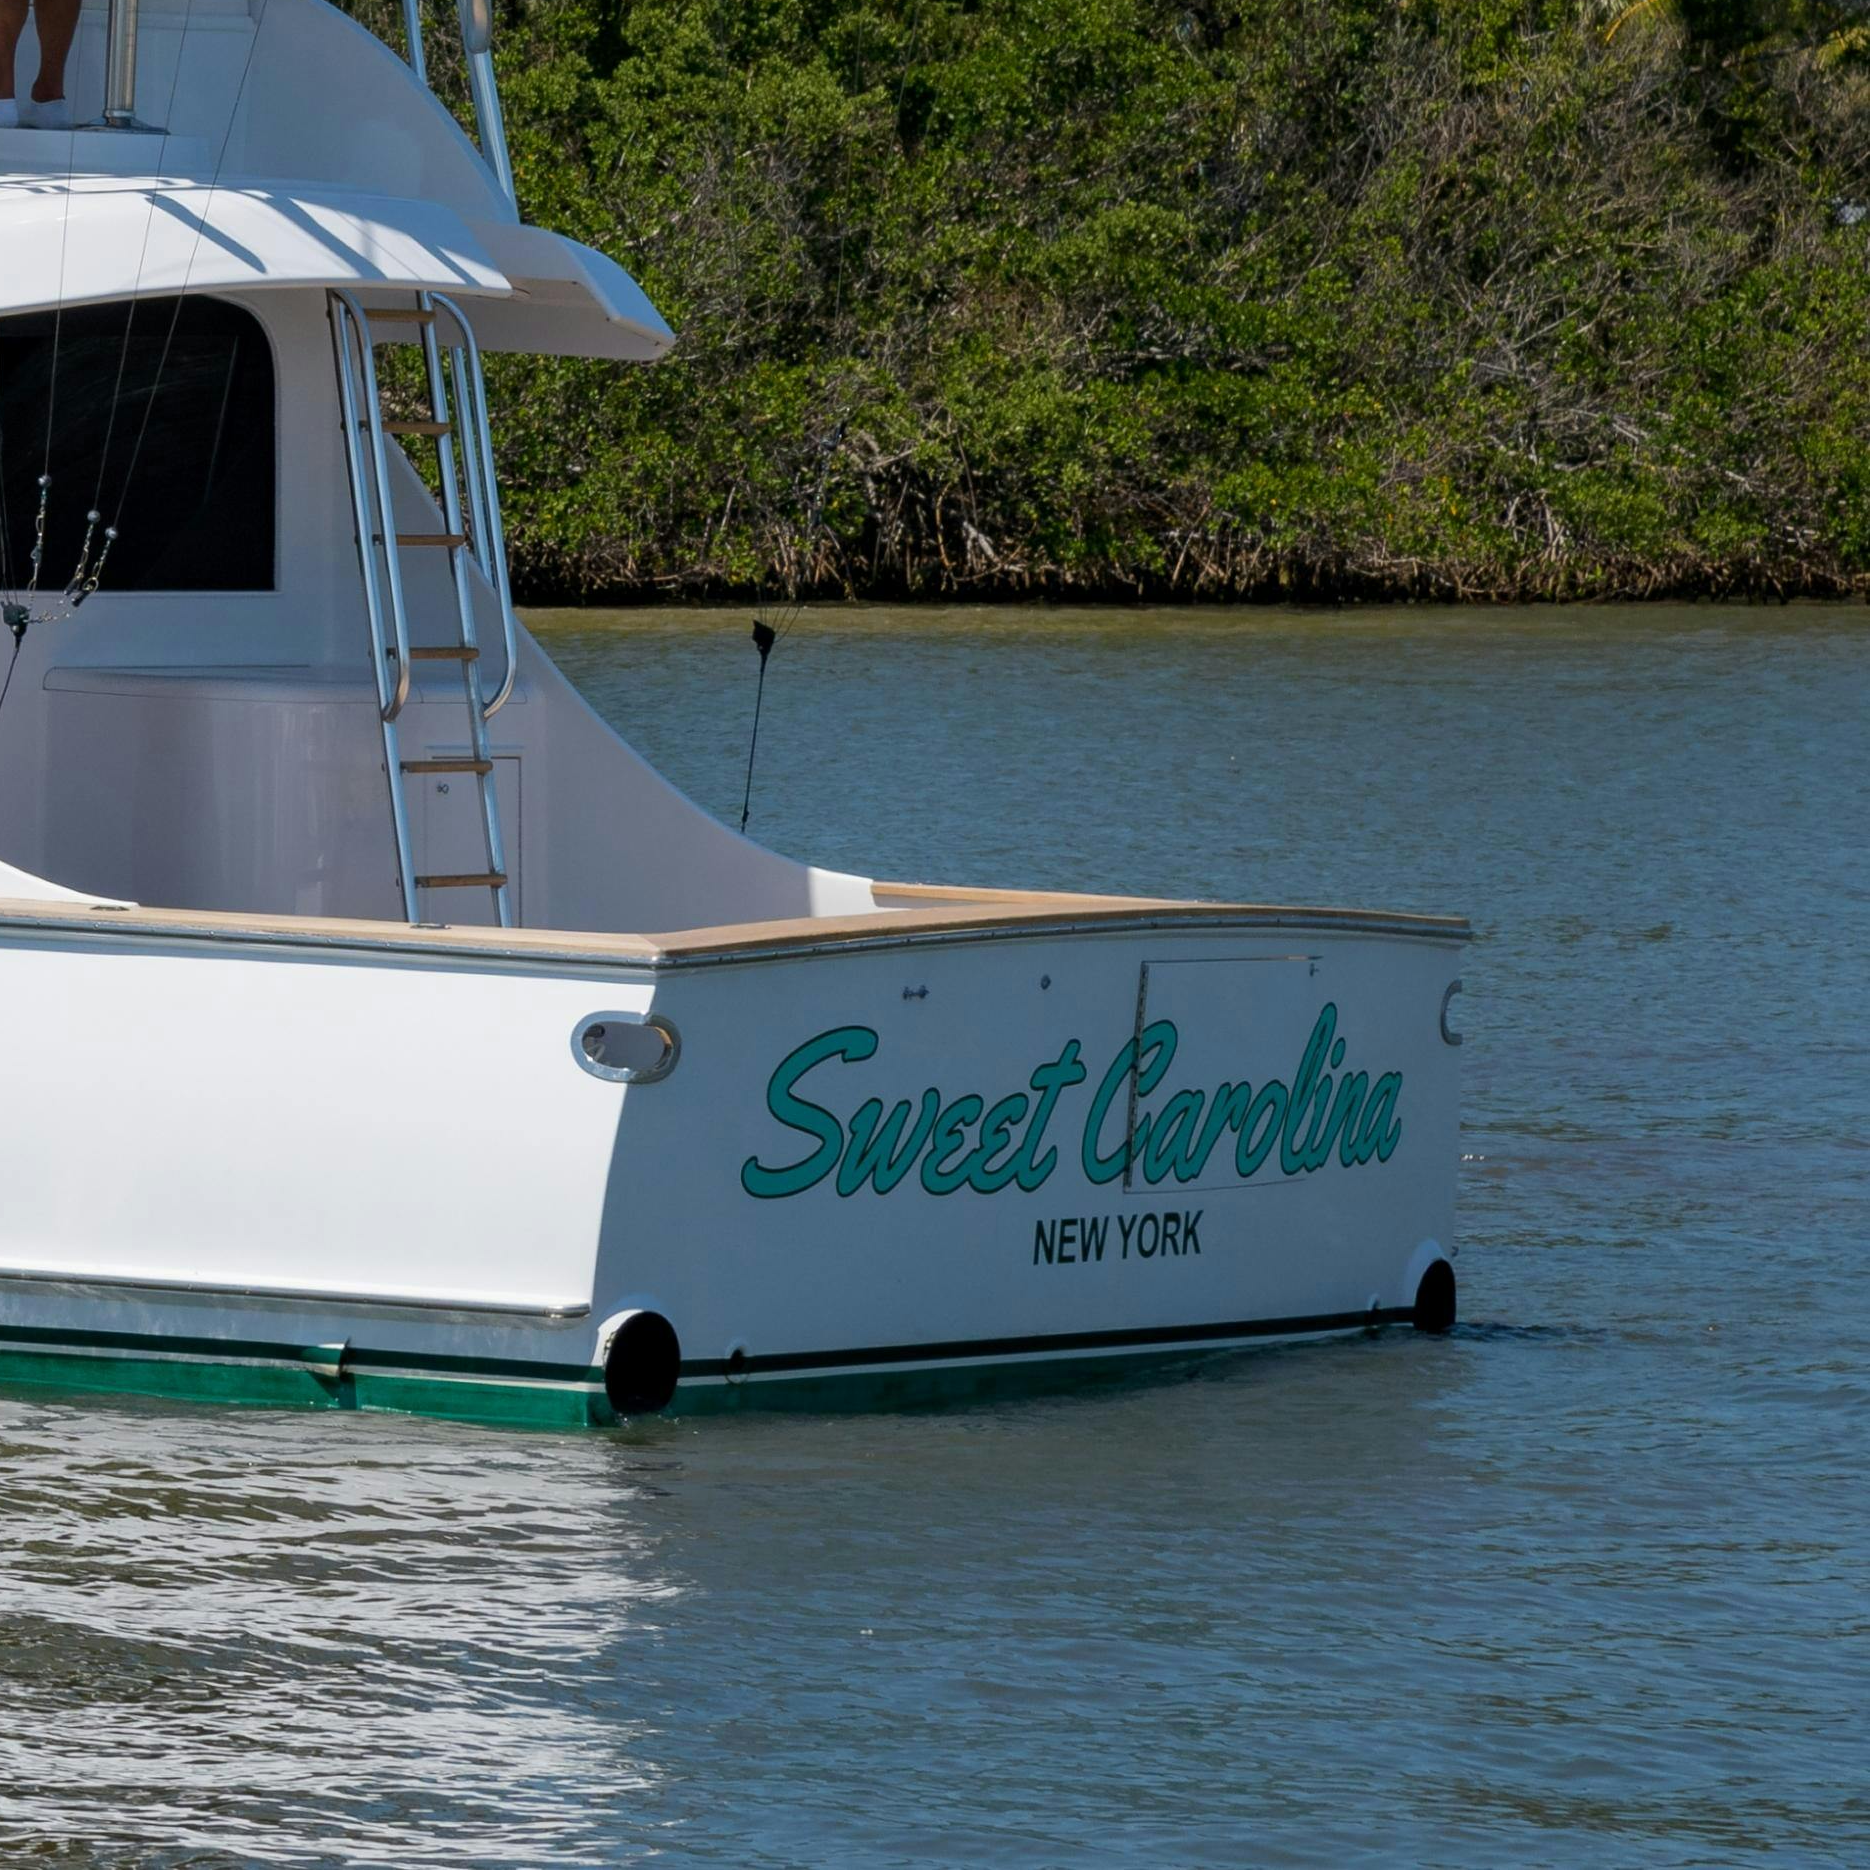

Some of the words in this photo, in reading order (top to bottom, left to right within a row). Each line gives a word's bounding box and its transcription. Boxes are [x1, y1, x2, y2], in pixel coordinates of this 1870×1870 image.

[741, 1025, 1087, 1198] Sweet
[1081, 1002, 1403, 1185] Carolina
[1033, 1216, 1110, 1265] NEW
[1117, 1210, 1204, 1260] YORK
